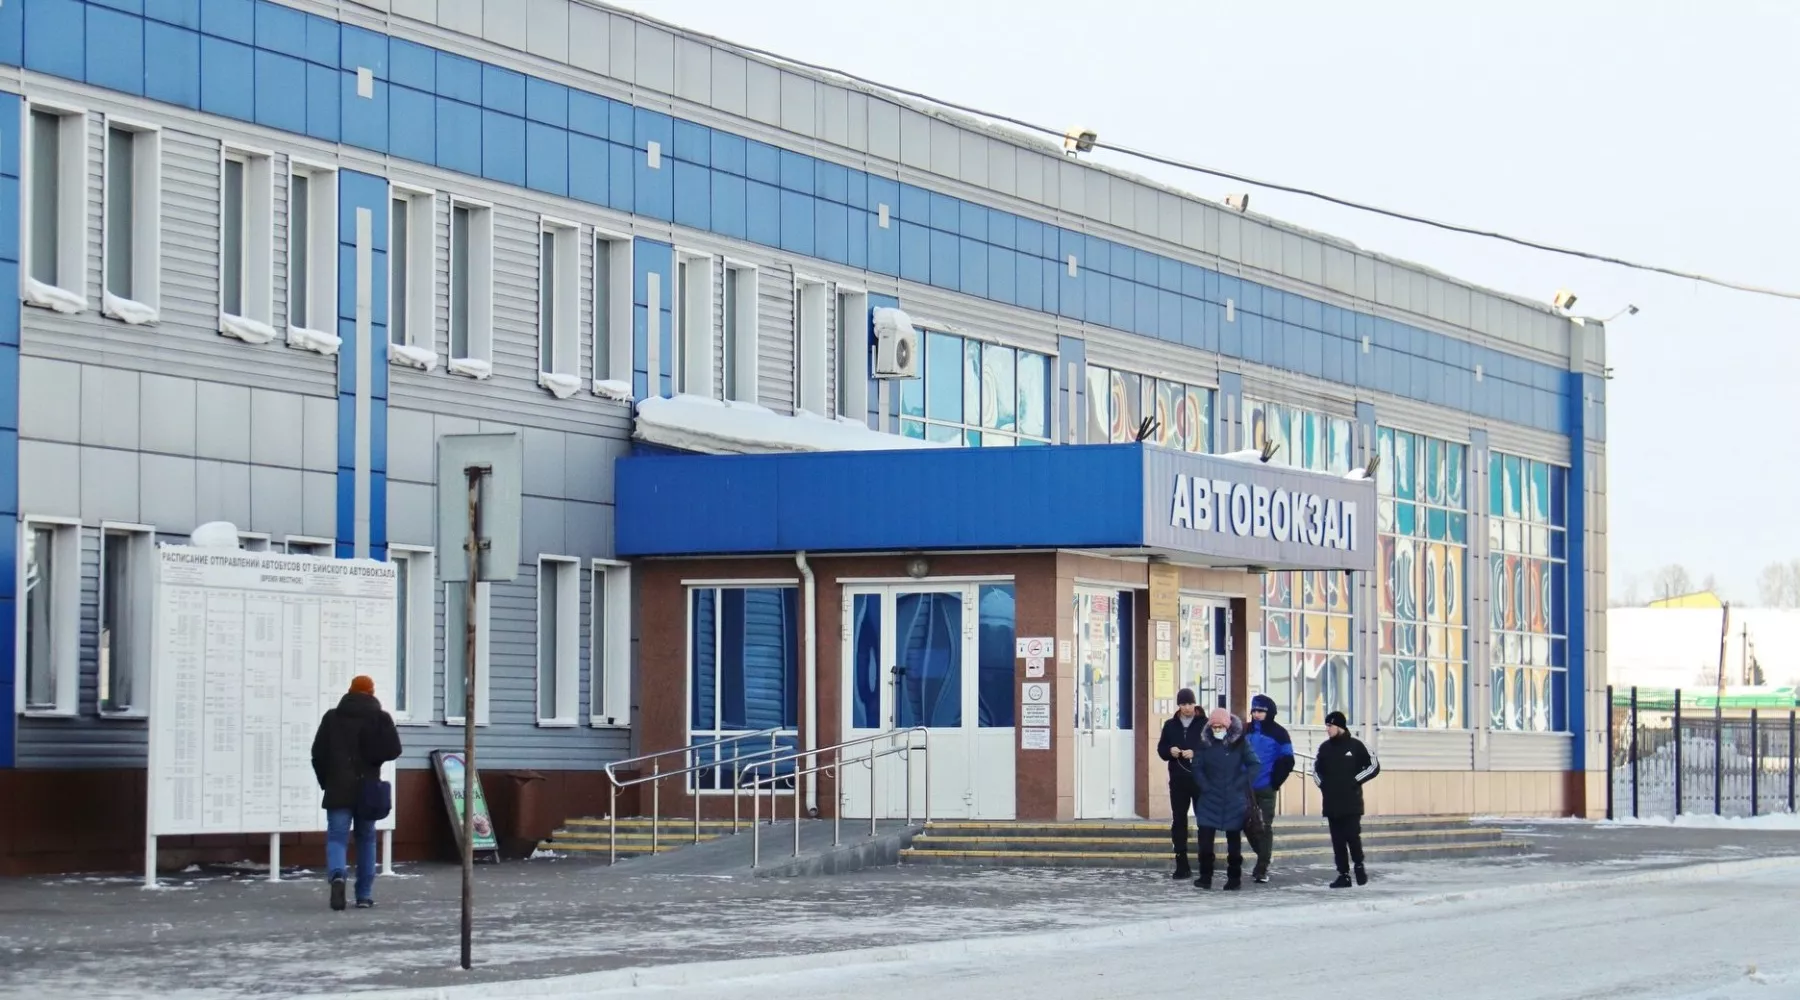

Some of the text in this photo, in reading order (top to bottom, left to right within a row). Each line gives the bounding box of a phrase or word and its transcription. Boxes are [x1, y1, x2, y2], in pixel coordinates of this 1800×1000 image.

[1171, 474, 1357, 551] АВТОВОКЗАЛ
[162, 552, 209, 565] РАСПИСАНИЕ
[261, 559, 301, 572] АВТОБУСОВ
[302, 563, 311, 572] ОТ
[349, 566, 395, 578] АВТОВОКЗАЛА
